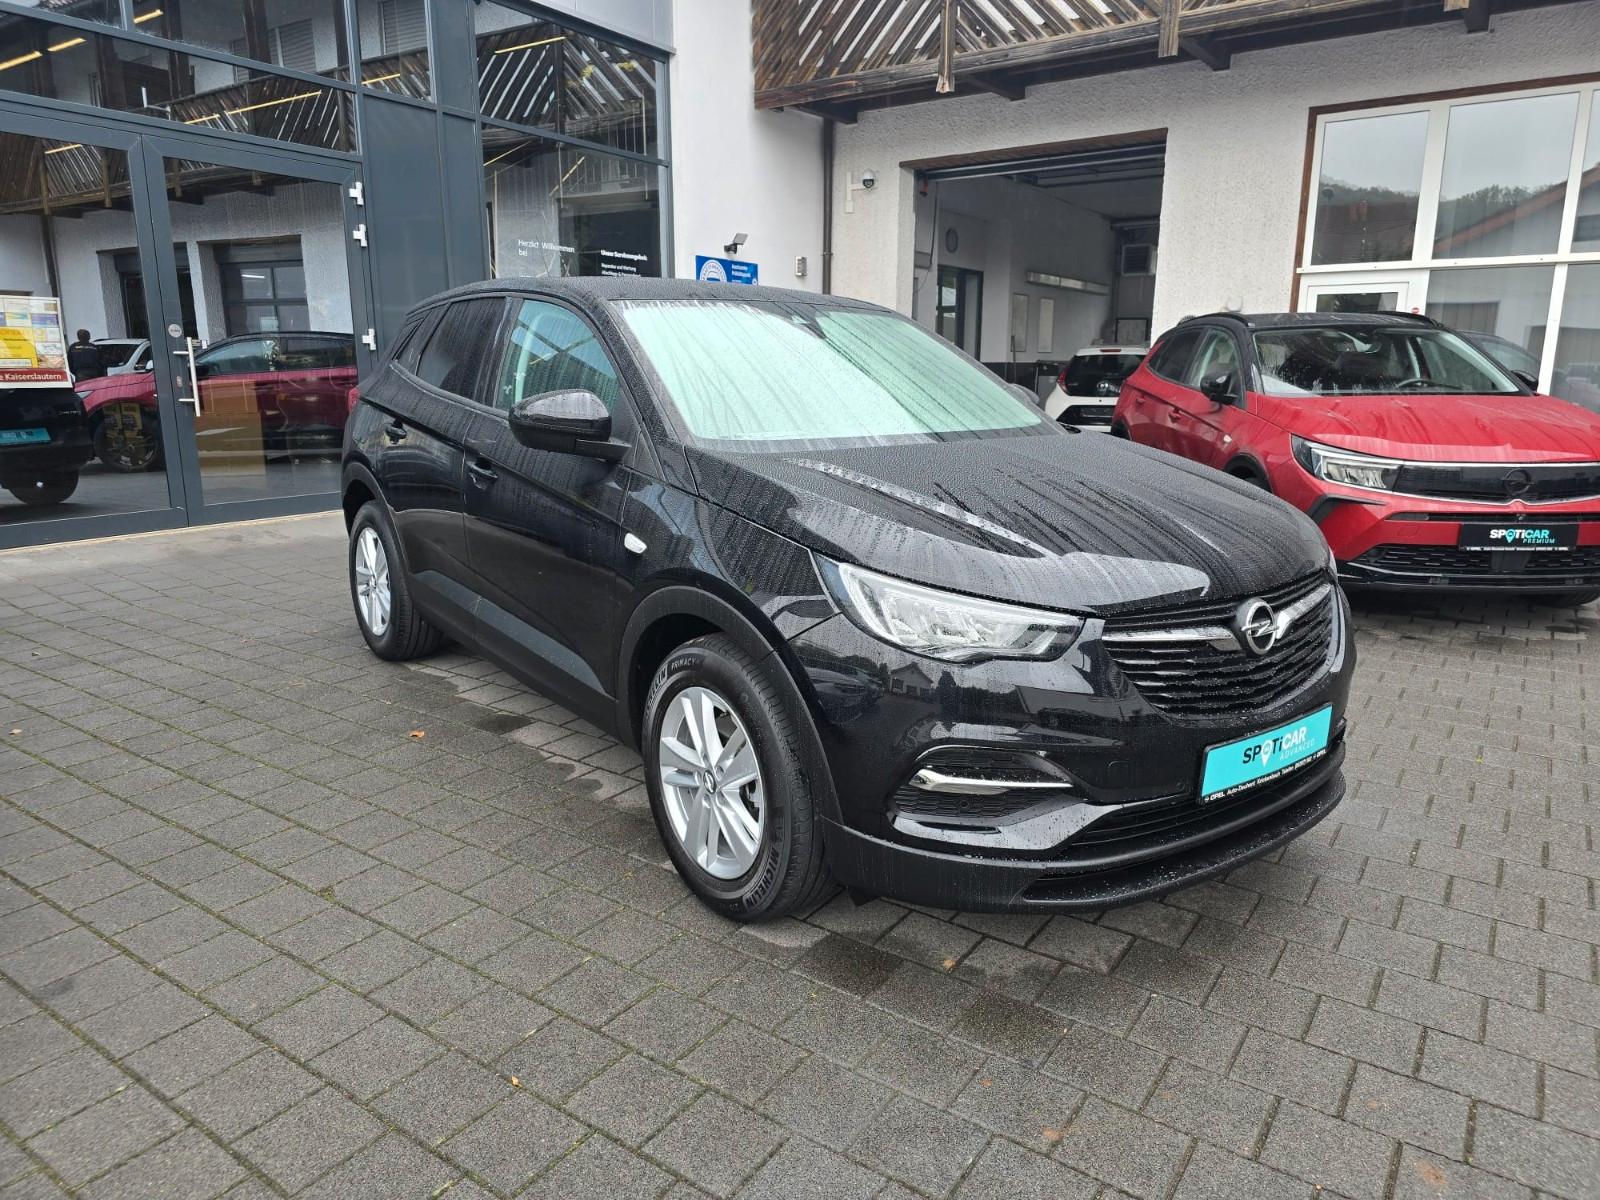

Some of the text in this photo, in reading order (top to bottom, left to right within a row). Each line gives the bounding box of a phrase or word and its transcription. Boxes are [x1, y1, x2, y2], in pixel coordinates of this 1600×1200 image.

[5, 373, 62, 381] Kaiserslautern
[671, 657, 696, 671] PRIMACY
[1280, 737, 1316, 761] ADVANCED
[1210, 791, 1225, 801] OPEL
[745, 846, 780, 909] MICHELIN
